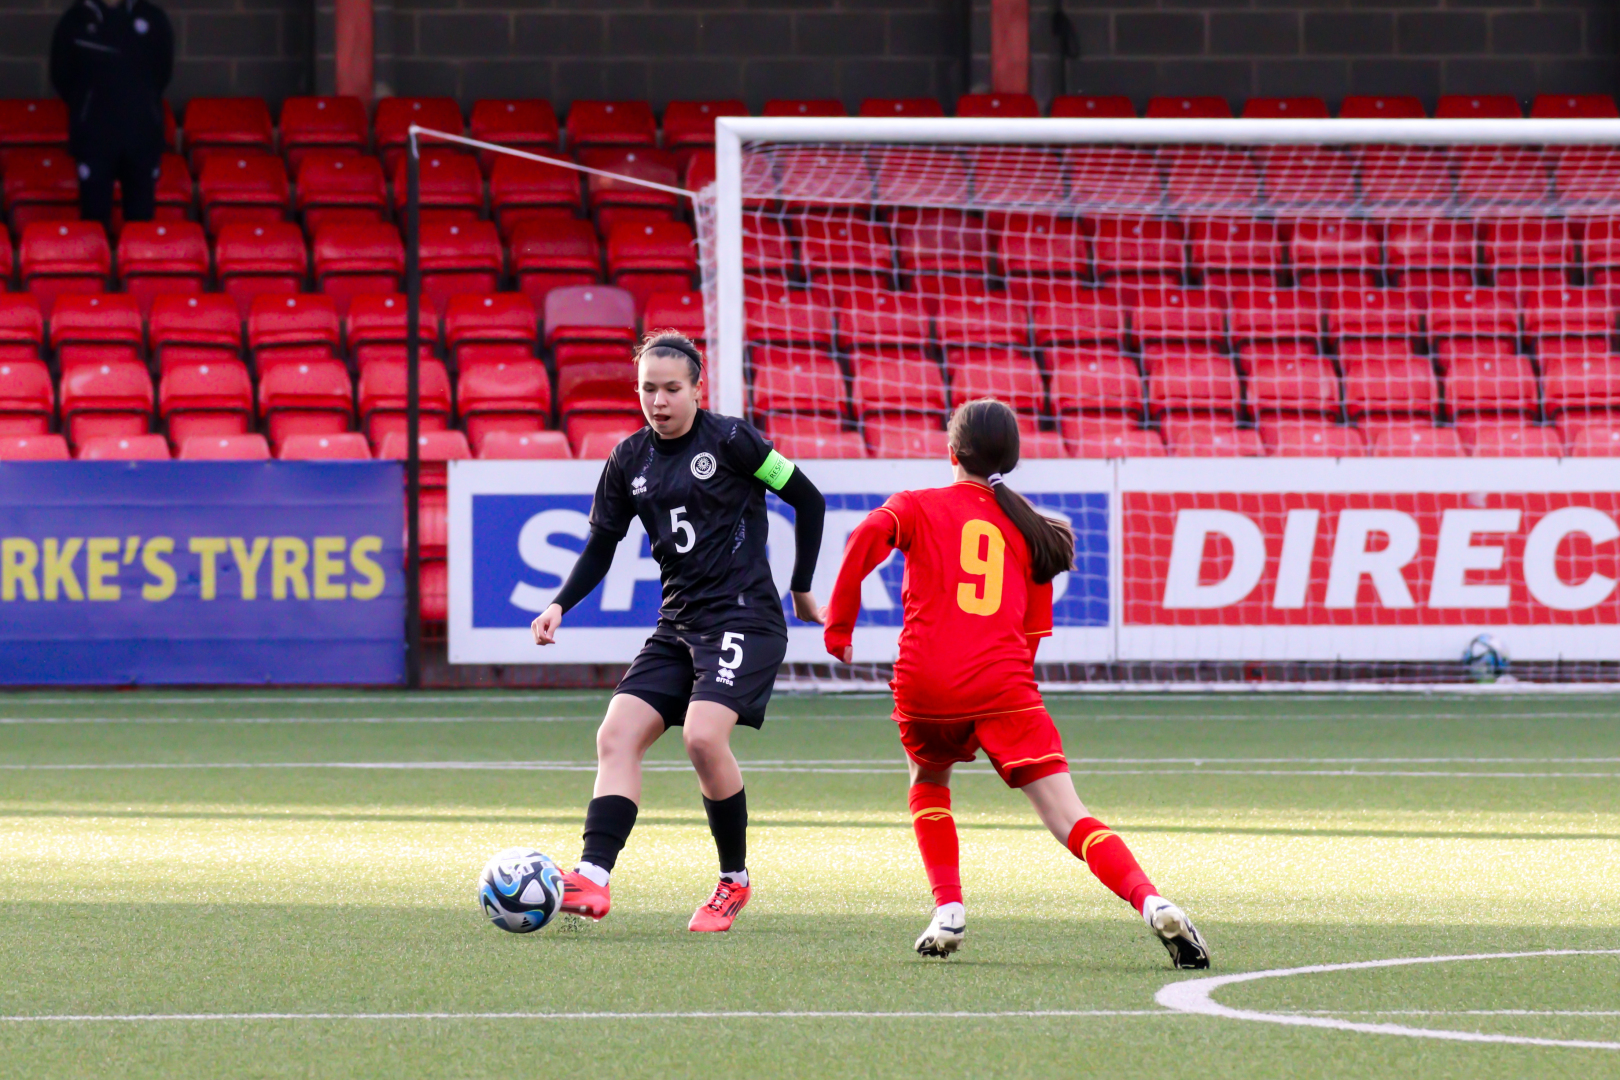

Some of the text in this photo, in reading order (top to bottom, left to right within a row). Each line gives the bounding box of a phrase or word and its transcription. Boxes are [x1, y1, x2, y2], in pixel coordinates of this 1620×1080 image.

[669, 505, 696, 554] 5
[1162, 505, 1620, 611] DIREC
[0, 535, 386, 601] RKE'S TYRES
[956, 518, 1006, 617] 9
[718, 631, 745, 670] 5
